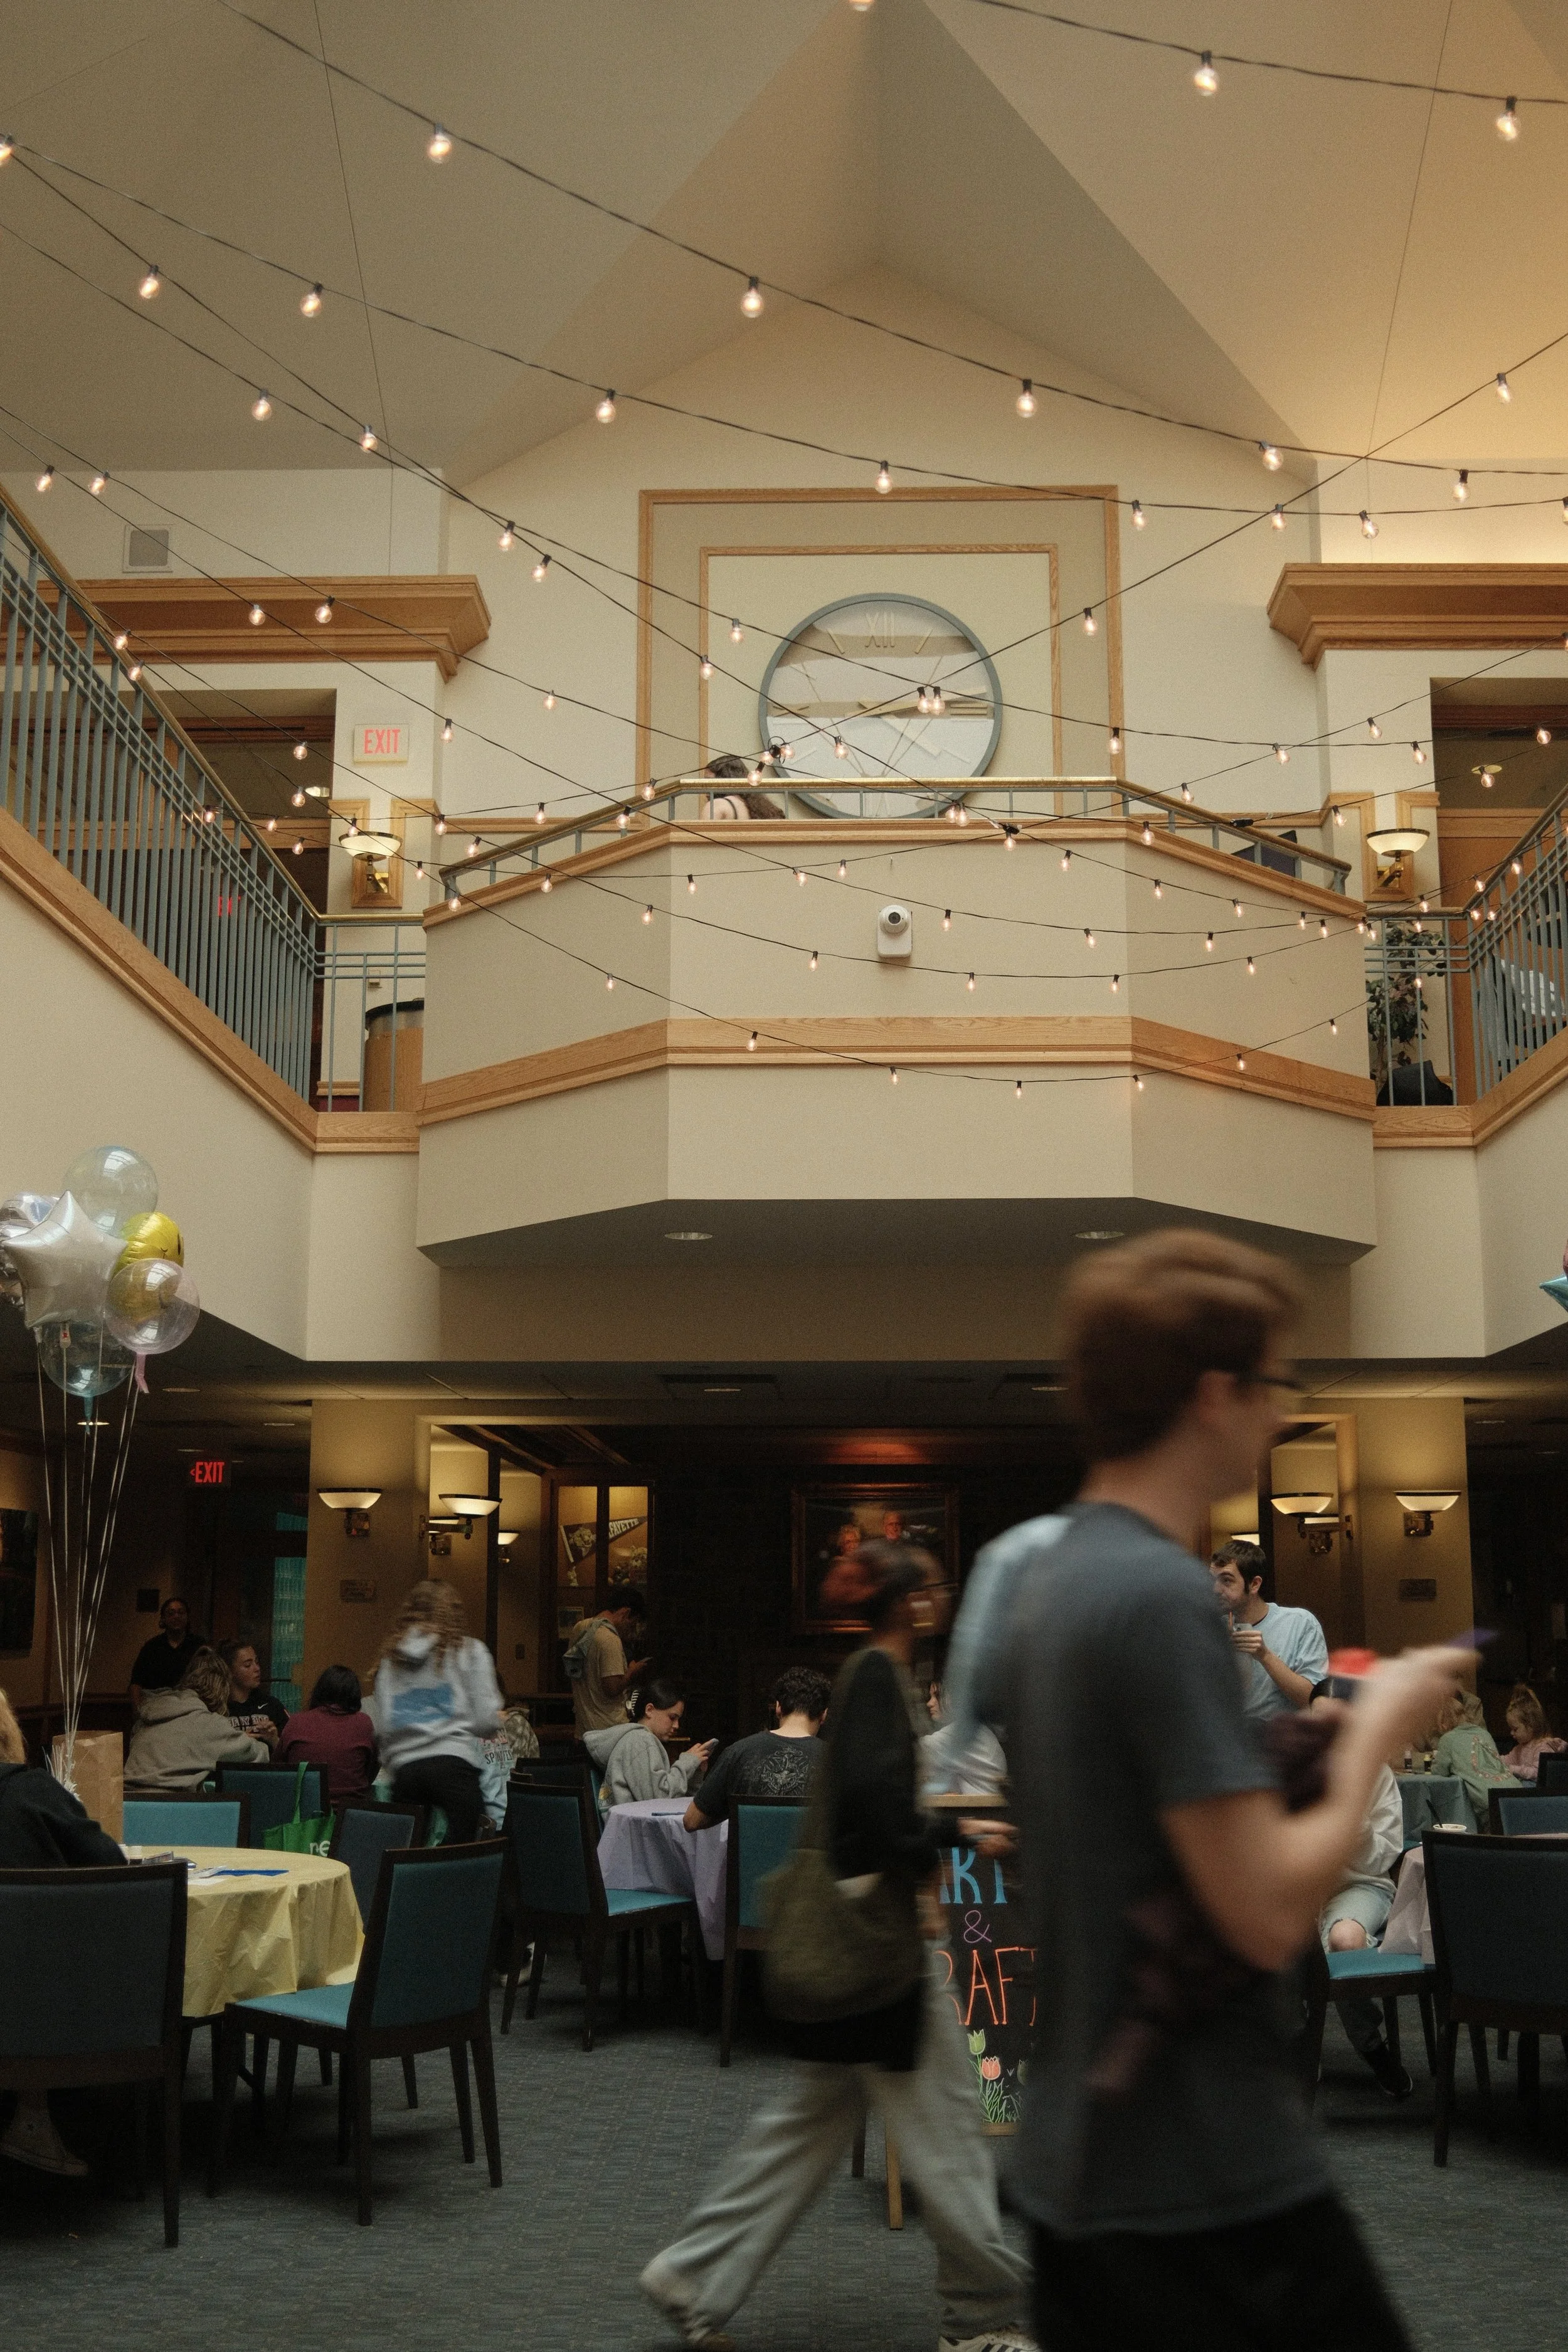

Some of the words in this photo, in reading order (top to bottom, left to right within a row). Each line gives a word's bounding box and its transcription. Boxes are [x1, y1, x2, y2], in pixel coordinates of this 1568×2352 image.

[364, 728, 400, 754] EXIT
[195, 1461, 225, 1483] EXIT
[608, 1518, 639, 1539] FAYETTE
[963, 1910, 992, 1943] &
